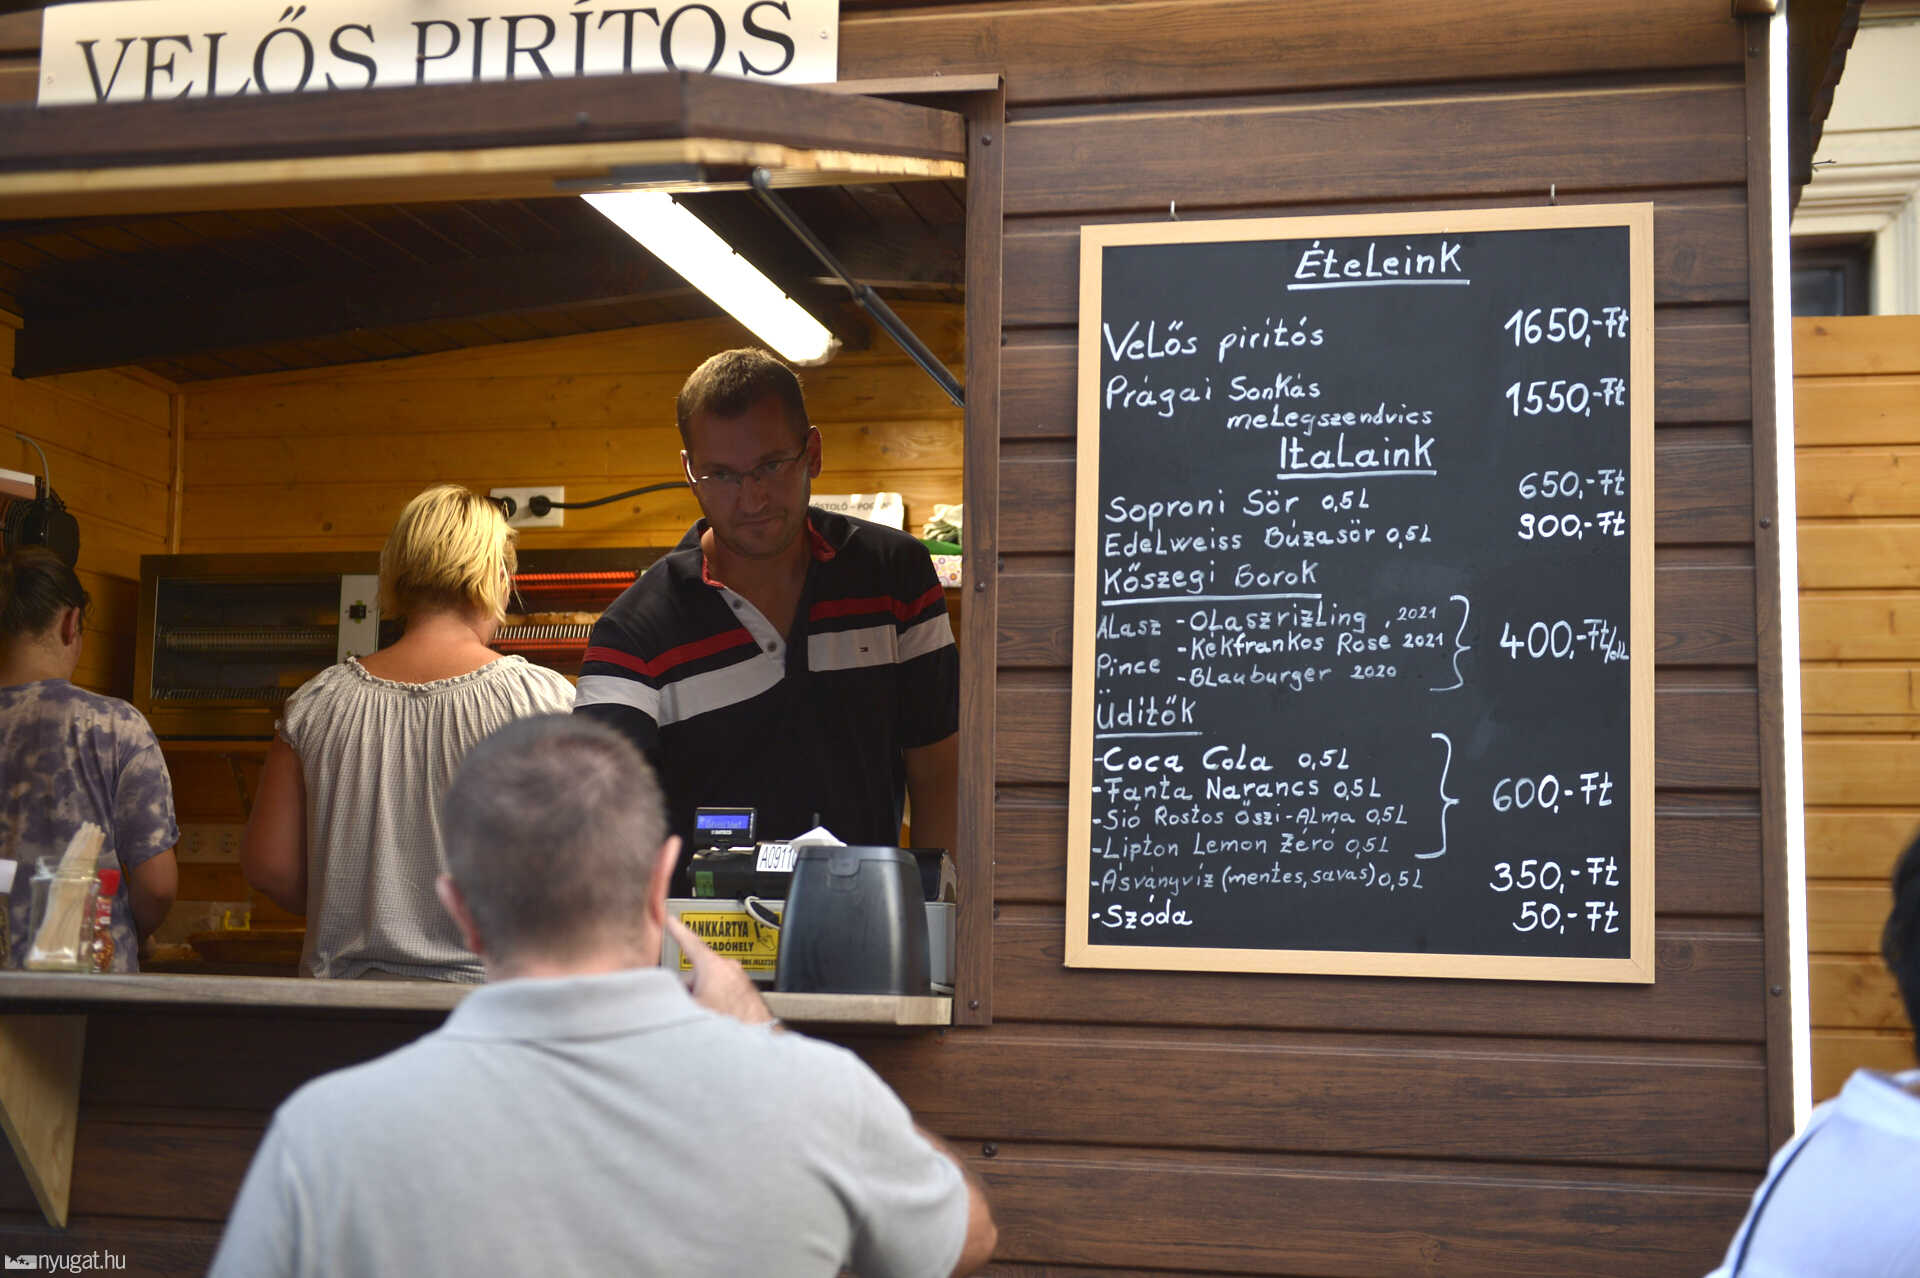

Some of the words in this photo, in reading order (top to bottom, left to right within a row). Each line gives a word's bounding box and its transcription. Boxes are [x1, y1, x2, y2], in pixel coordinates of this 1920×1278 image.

[76, 6, 378, 102] VELŐS
[1106, 375, 1212, 417] Prágai
[1105, 489, 1225, 532] Soproni
[1243, 489, 1299, 516] Sör
[1264, 519, 1376, 549] Búzasör
[1104, 560, 1215, 594] Kőszegi
[1397, 606, 1437, 621] 2021
[1402, 632, 1443, 648] 2021
[1096, 653, 1161, 679] Pince
[1350, 664, 1397, 679] 2020
[1206, 776, 1319, 800] Narancs
[1155, 803, 1225, 826] Rostos
[1193, 832, 1268, 855] Lemon
